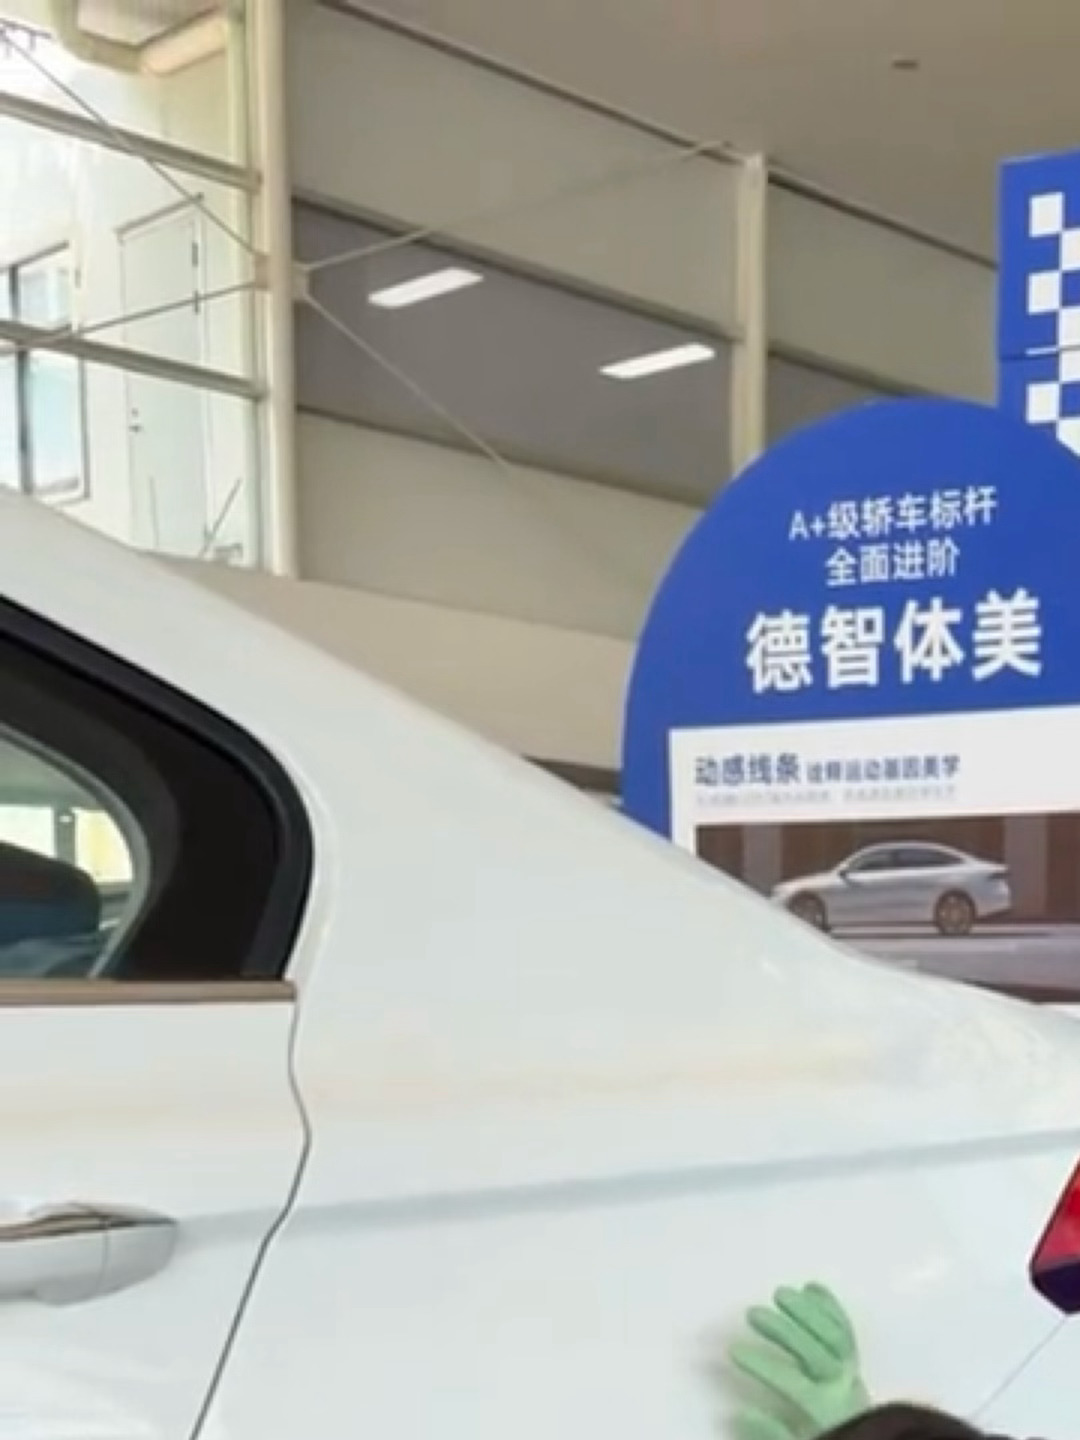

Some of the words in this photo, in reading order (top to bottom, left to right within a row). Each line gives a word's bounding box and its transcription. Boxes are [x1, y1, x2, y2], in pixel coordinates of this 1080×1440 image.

[789, 486, 998, 541] A+级轿车标杆
[824, 538, 960, 587] 全面进阶
[745, 588, 1042, 693] 德智体美
[695, 752, 798, 786] 动感线条
